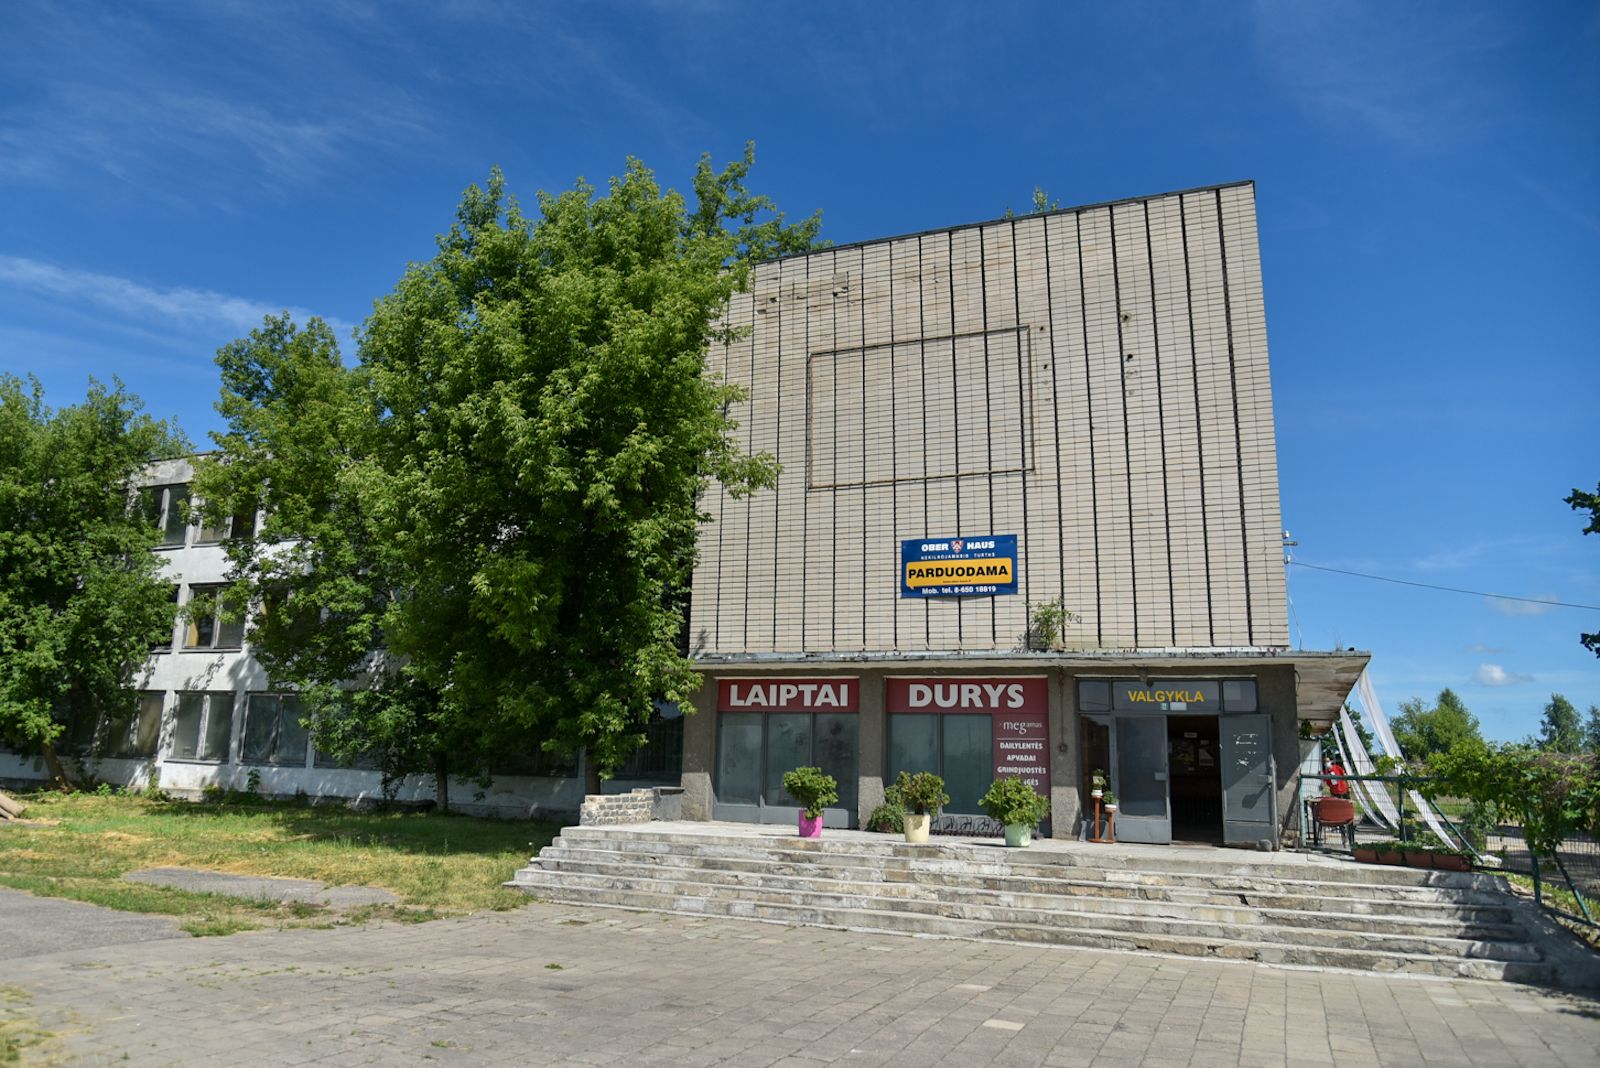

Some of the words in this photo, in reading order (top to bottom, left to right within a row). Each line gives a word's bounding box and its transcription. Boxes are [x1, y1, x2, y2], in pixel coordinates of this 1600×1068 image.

[921, 543, 949, 552] OBER
[966, 541, 995, 549] HAUS
[908, 565, 1008, 579] PARDUODAMA
[730, 684, 848, 706] LAIPTAI
[909, 684, 1025, 708] DURYS
[1127, 690, 1204, 702] VALGYKLA
[997, 766, 1046, 774] GRINDJUOSTĖS
